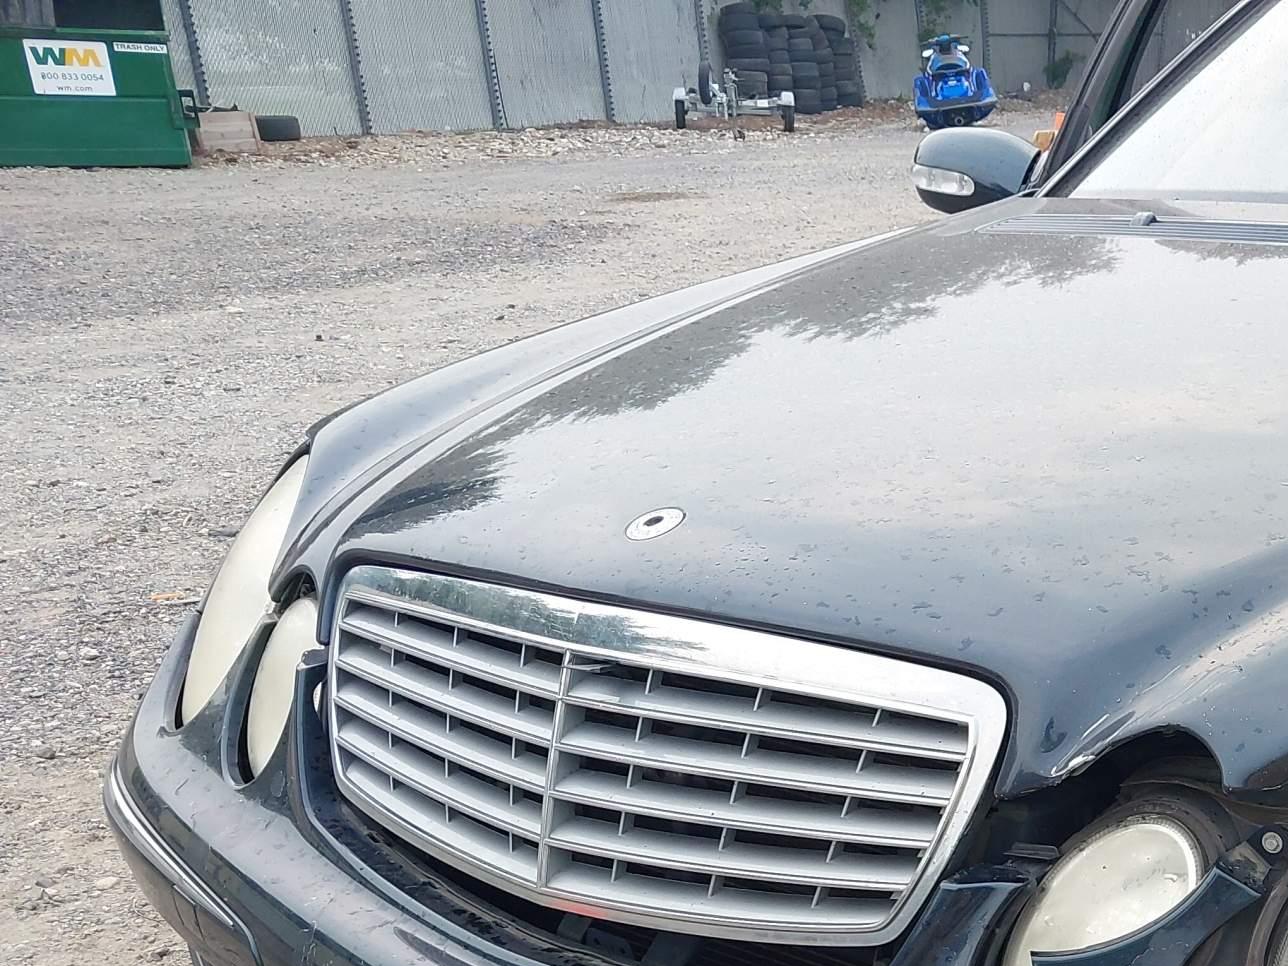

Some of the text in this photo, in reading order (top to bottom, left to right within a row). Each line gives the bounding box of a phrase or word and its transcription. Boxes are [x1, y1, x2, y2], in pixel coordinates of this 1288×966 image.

[28, 46, 103, 67] WM
[61, 72, 79, 81] 833
[80, 73, 104, 81] 0054
